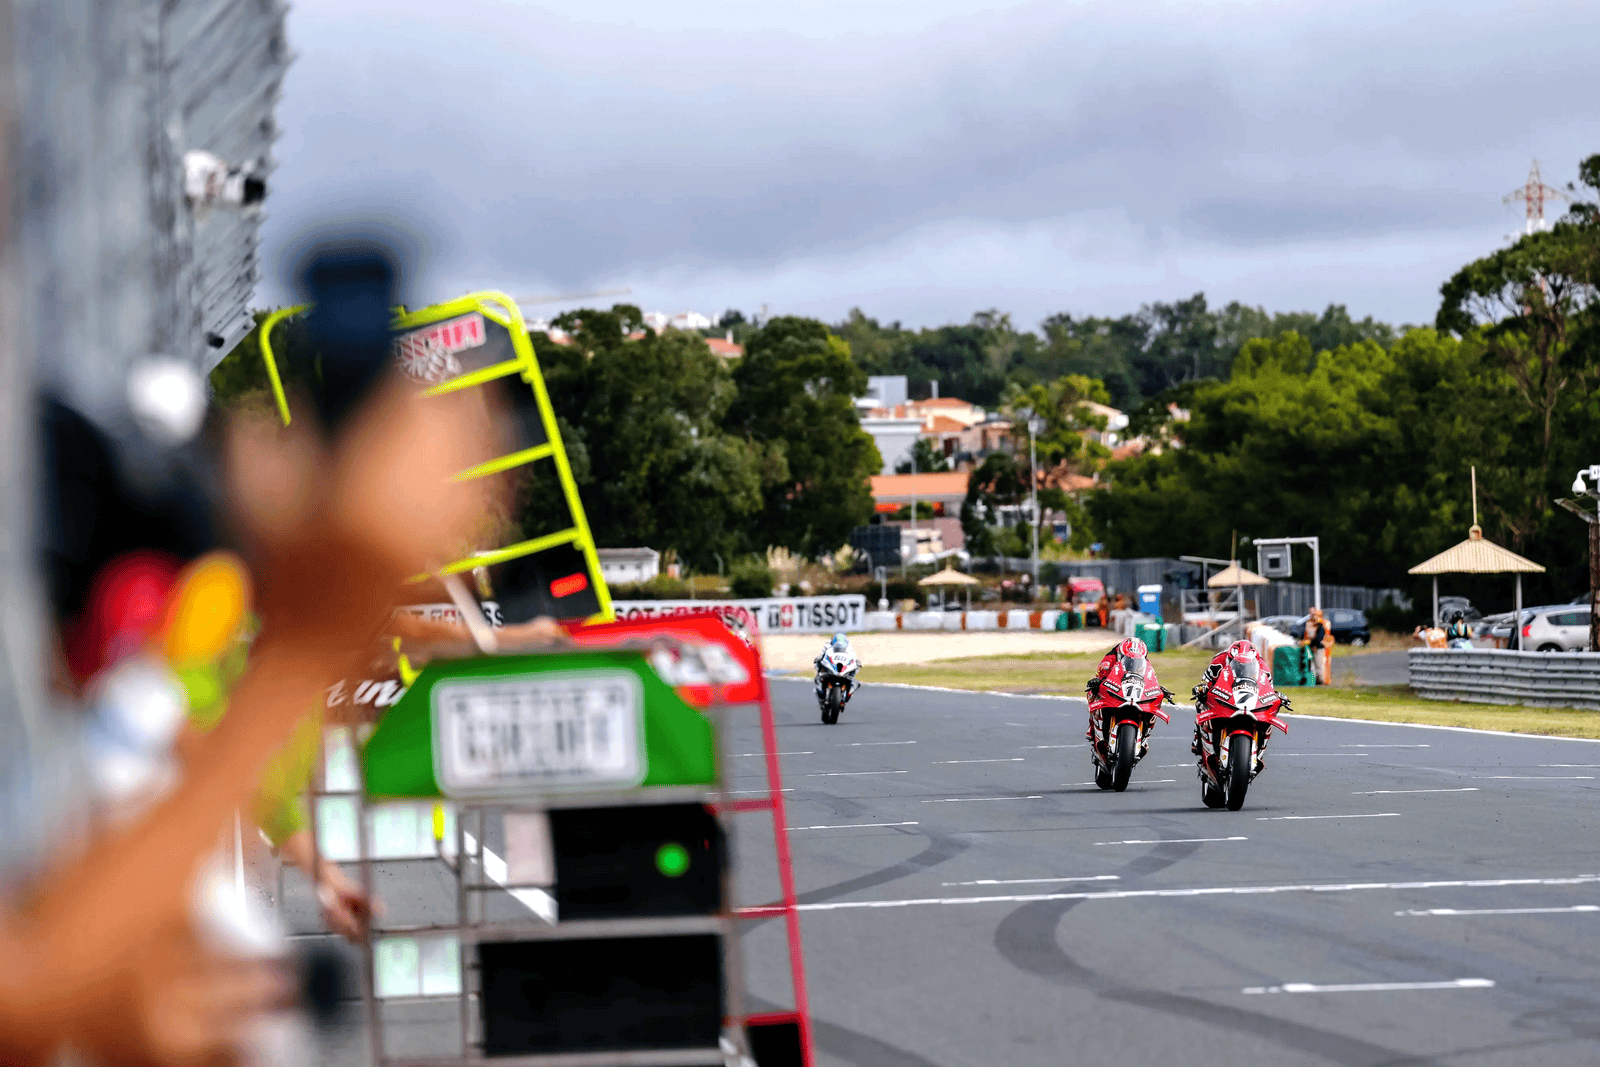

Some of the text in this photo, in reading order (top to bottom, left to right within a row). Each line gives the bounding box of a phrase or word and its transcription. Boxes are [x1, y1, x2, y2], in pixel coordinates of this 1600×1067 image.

[797, 602, 860, 627] TISSOT
[1126, 686, 1142, 699] 11
[1237, 691, 1254, 704] 7
